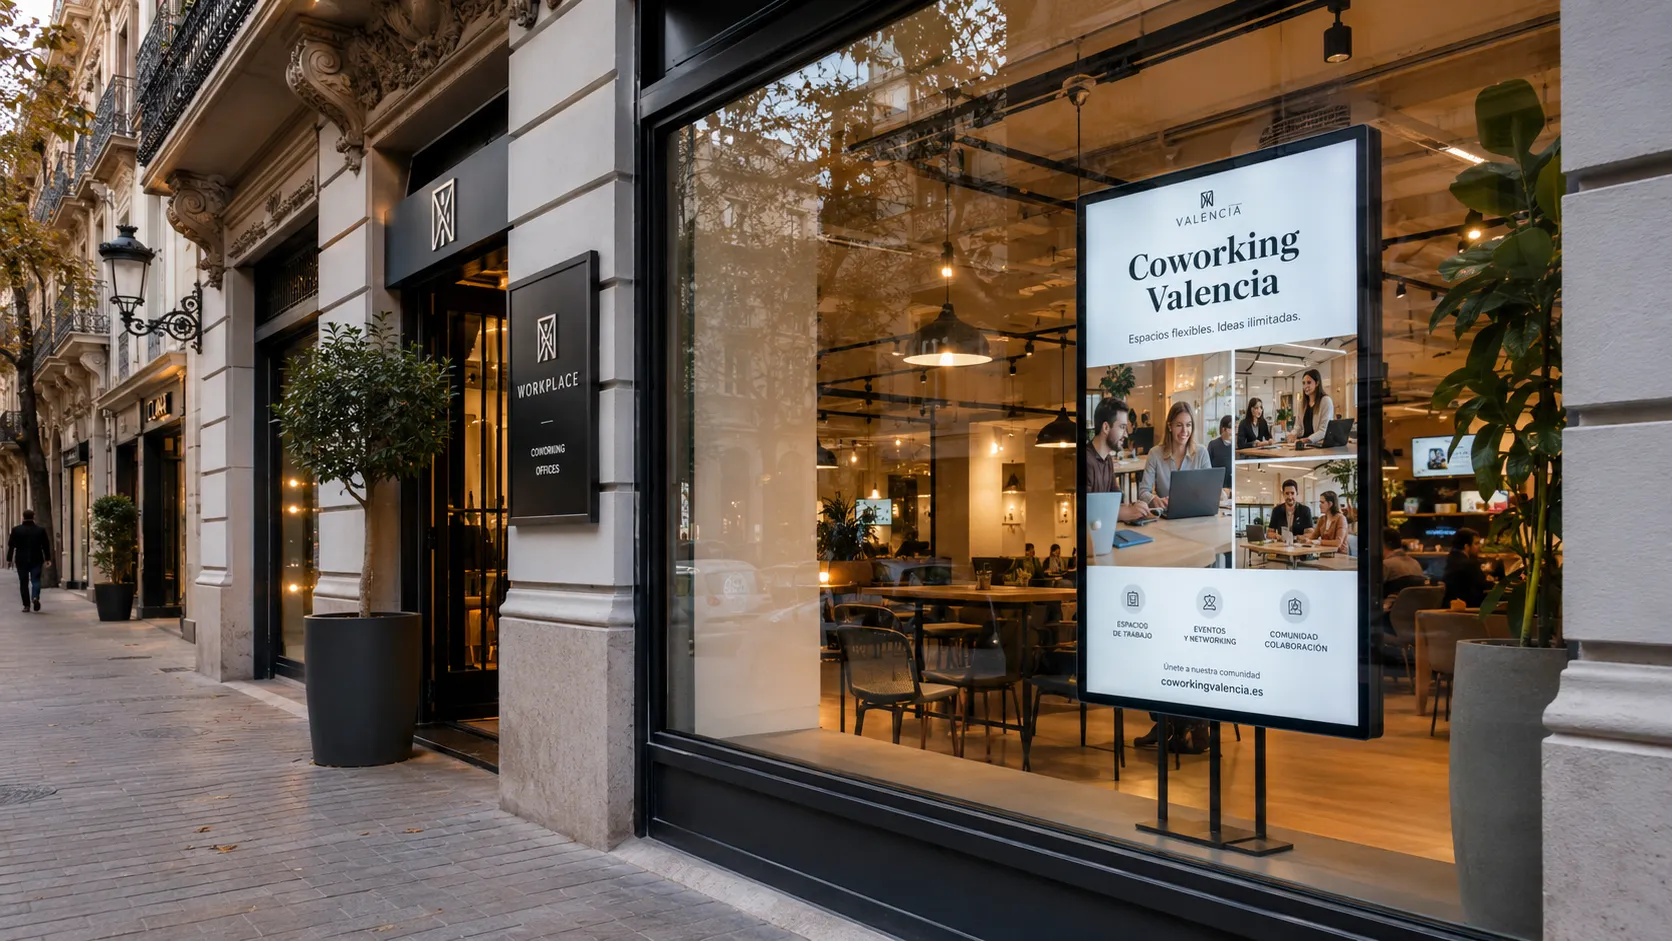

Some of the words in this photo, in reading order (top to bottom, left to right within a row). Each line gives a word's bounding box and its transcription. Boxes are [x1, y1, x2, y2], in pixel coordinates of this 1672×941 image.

[1128, 229, 1300, 281] Coworking
[1146, 268, 1280, 313] Valencia
[1128, 330, 1170, 345] Espacios
[1171, 324, 1215, 339] flexibles.
[1217, 319, 1245, 332] Ideas
[1247, 311, 1301, 328] ilimitadas.
[517, 371, 579, 399] WORKPLACE
[535, 463, 560, 476] OFFICES
[1112, 630, 1122, 638] DE
[1193, 625, 1226, 635] EVENTOS
[1269, 630, 1319, 641] COMUNIDAD
[1189, 635, 1237, 646] NETWORKING
[1163, 662, 1185, 672] Únete
[1191, 666, 1218, 676] nuestra
[1219, 669, 1261, 680] comunidad
[1160, 678, 1264, 697] coworkingvalencia.es
